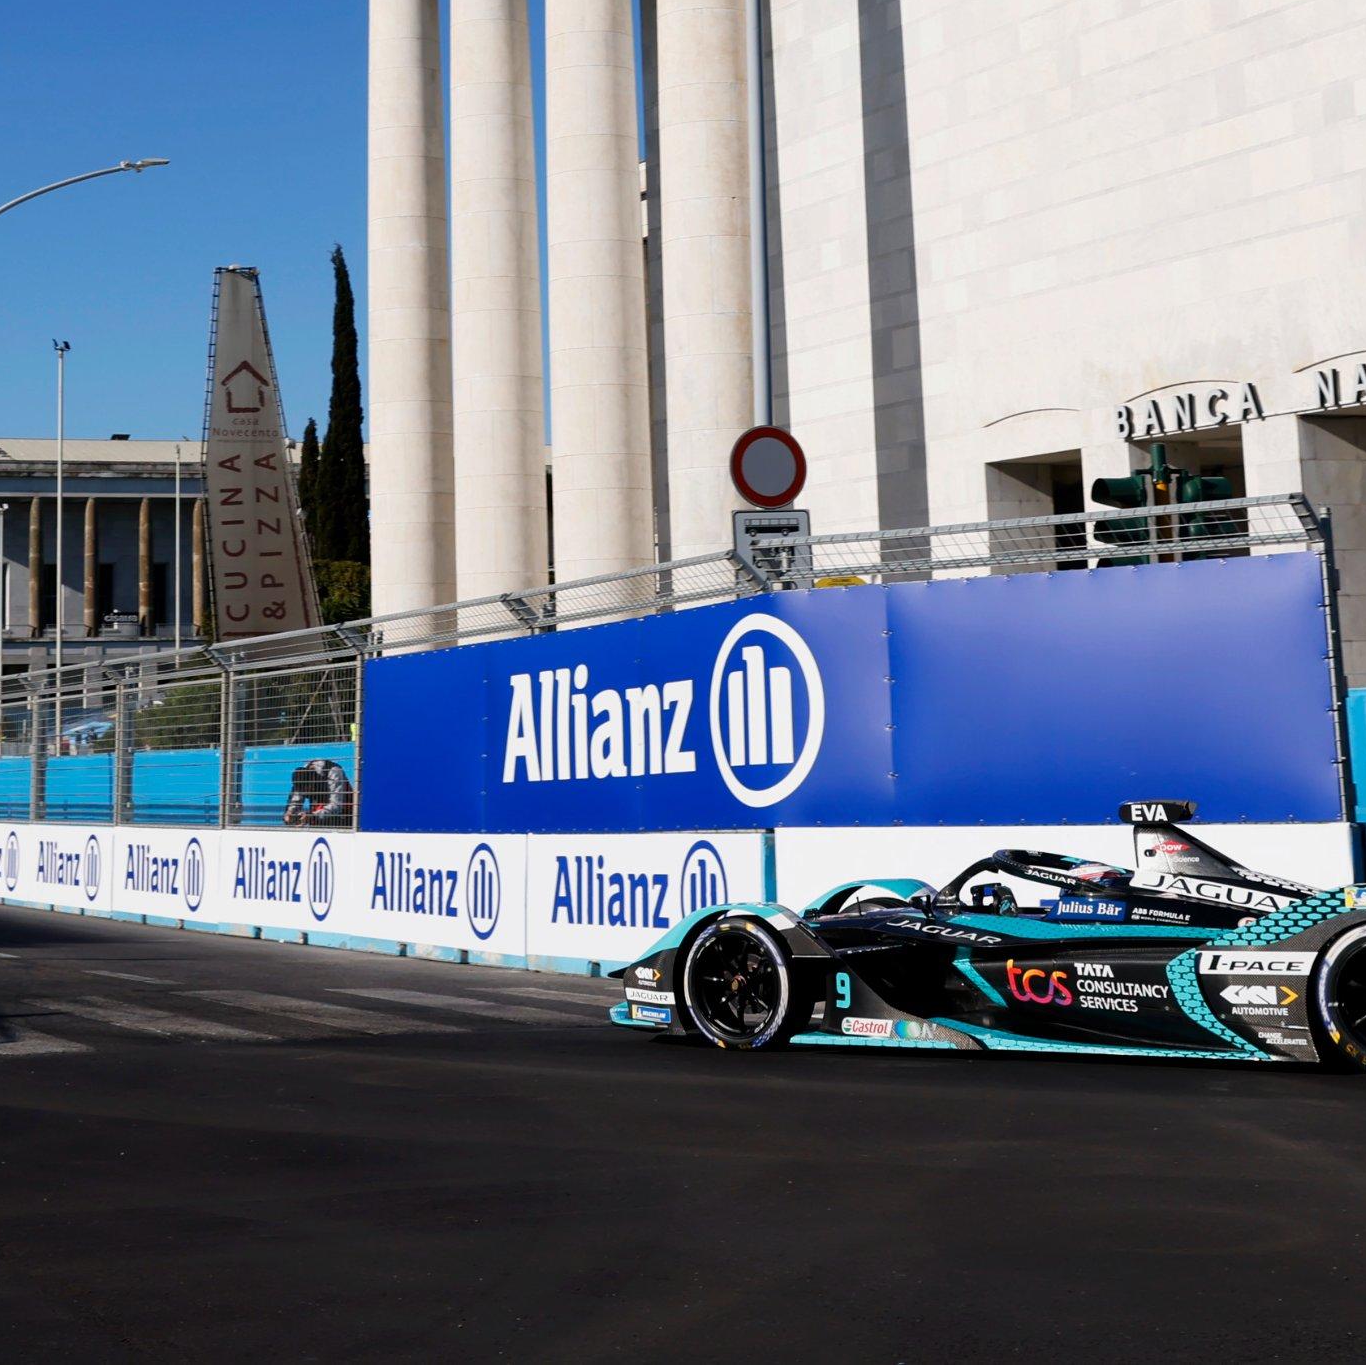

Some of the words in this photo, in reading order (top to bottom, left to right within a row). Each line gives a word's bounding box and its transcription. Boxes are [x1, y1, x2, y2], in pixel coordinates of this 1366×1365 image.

[1114, 383, 1264, 438] BANCA
[212, 427, 279, 437] Novecento
[254, 453, 284, 588] PIZZA
[218, 455, 250, 621] CUCINA
[262, 601, 286, 620] &
[502, 664, 697, 783] Allianz
[1130, 804, 1168, 822] EVA
[36, 840, 80, 886] Allianz
[125, 843, 179, 895] Allianz
[233, 846, 302, 903] Allianz
[371, 850, 458, 918] Allianz
[1024, 869, 1077, 886] JAGUAR
[551, 854, 670, 930] Allianz
[1057, 901, 1093, 916] Julius
[1097, 902, 1122, 917] Bär
[1132, 907, 1148, 915] ABB
[1148, 909, 1184, 920] FORMULA
[886, 920, 1002, 944] JAGUAR
[1074, 962, 1115, 978] TATA
[1208, 955, 1304, 971] I-PACE
[835, 972, 851, 1009] 9
[1006, 958, 1073, 1006] tcs
[1076, 979, 1169, 999] CONSULTANCY
[630, 991, 668, 1001] JAGUAR
[1080, 995, 1139, 1013] SERVICES
[1232, 1007, 1289, 1016] AUTOMOTIVE
[852, 1019, 888, 1034] Castrol
